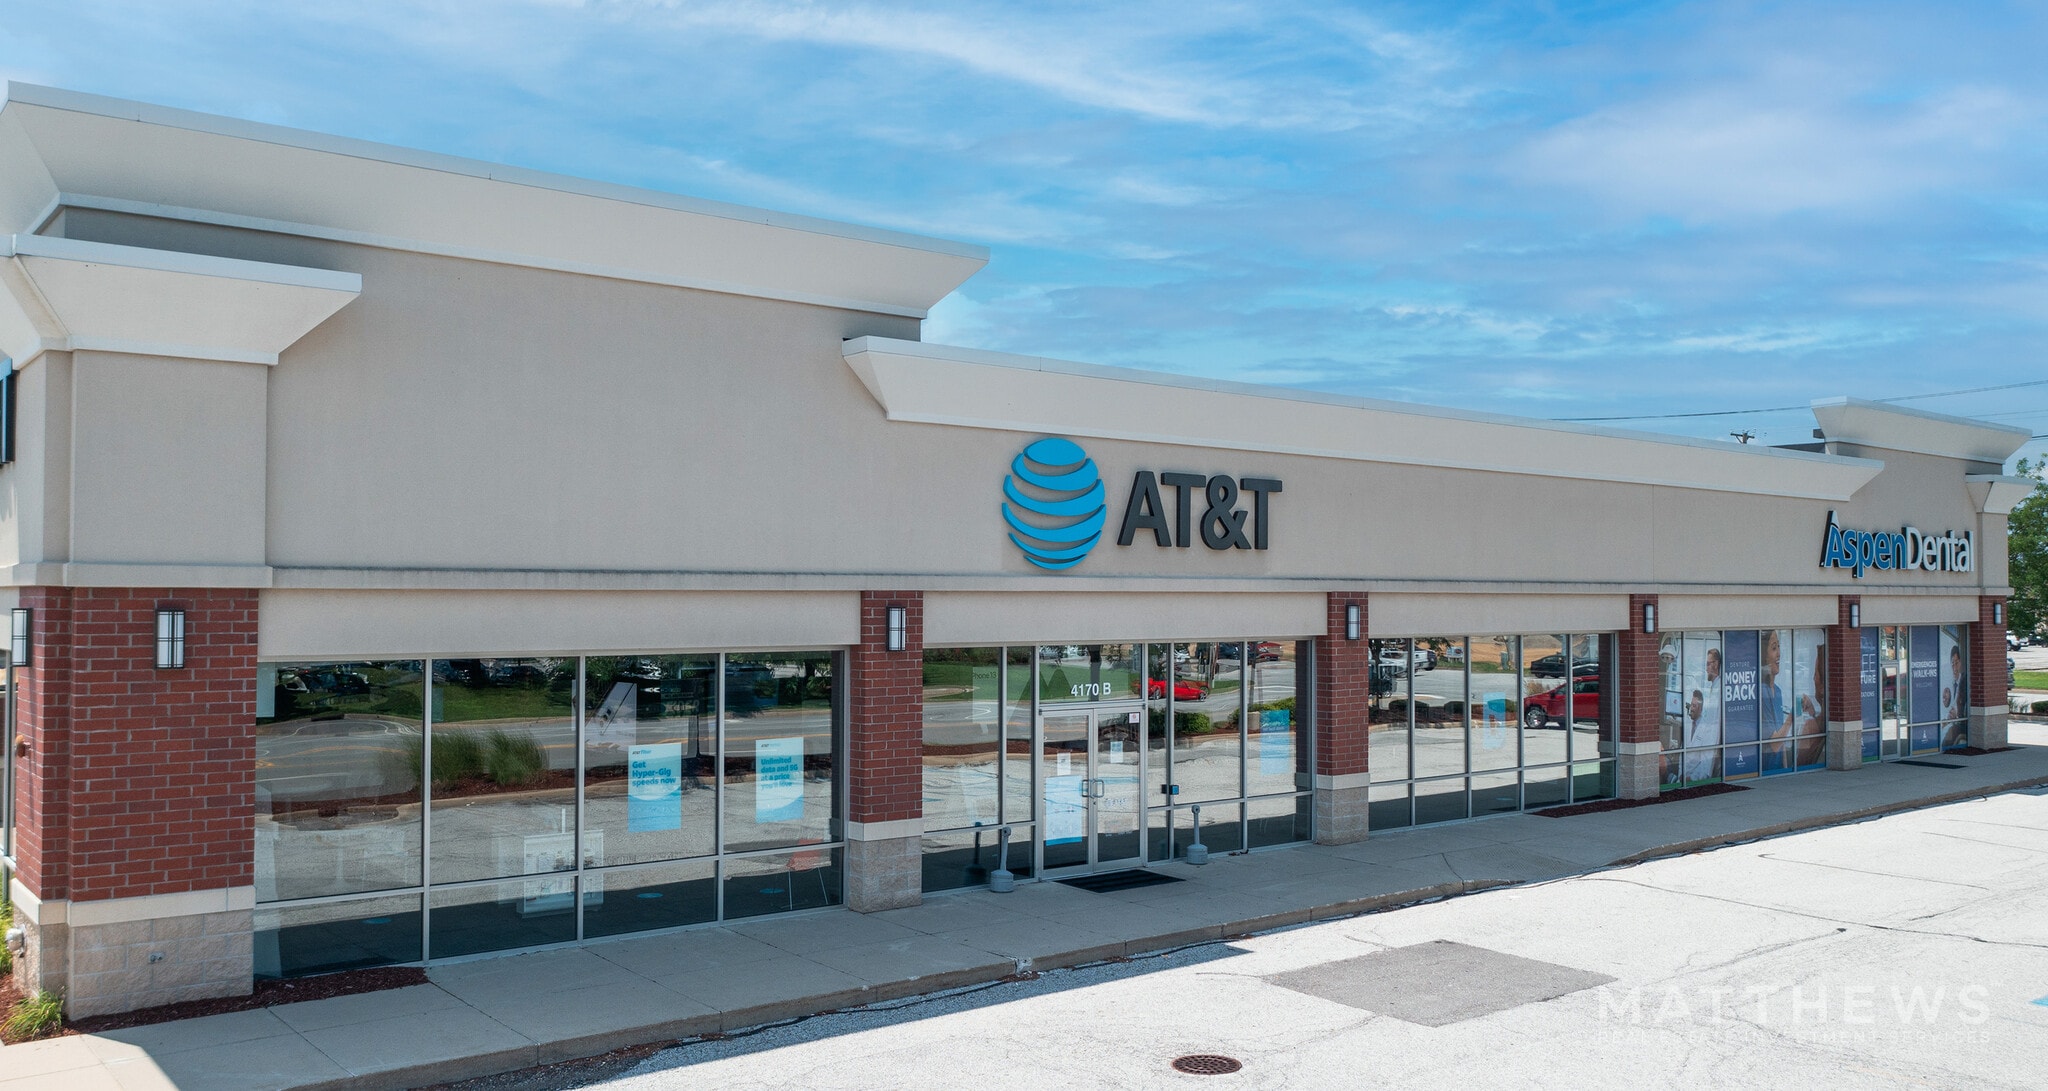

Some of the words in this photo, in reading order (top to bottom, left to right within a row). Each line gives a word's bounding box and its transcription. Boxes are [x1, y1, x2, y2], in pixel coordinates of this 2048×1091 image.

[1117, 470, 1283, 550] AT&T
[1862, 653, 1876, 673] EE
[1725, 671, 1756, 684] MONEY
[1861, 674, 1876, 684] TURE
[1071, 683, 1100, 697] 4170
[1102, 682, 1112, 695] B
[1725, 684, 1756, 702] BACK
[632, 761, 646, 769] Get
[761, 756, 792, 765] Unlimited
[632, 768, 672, 779] Hyper-Gig
[774, 773, 790, 781] price
[632, 778, 659, 787] speeds
